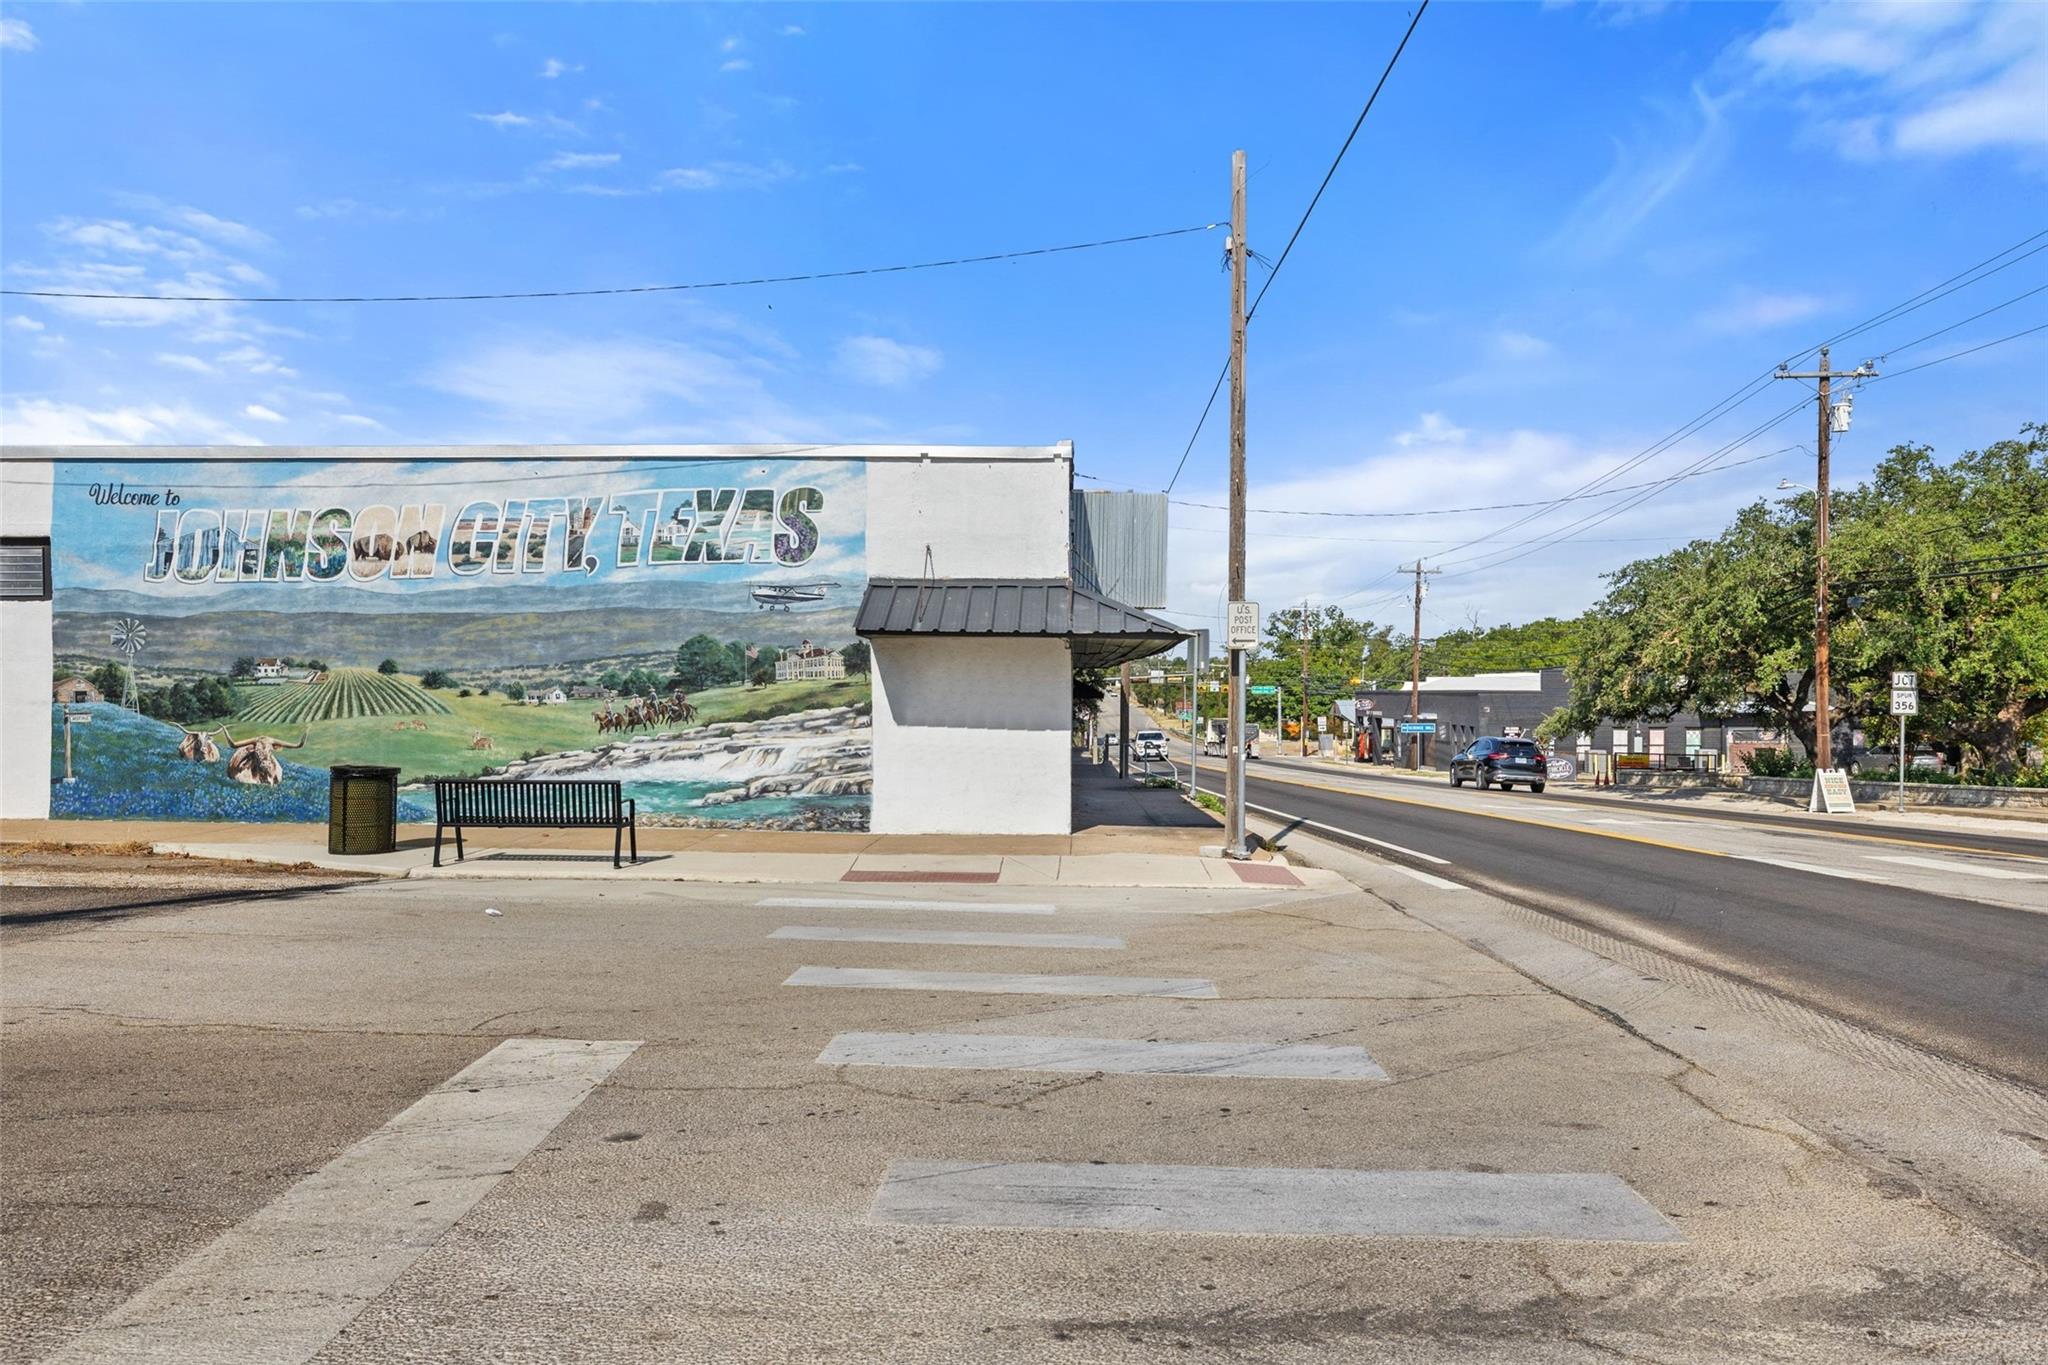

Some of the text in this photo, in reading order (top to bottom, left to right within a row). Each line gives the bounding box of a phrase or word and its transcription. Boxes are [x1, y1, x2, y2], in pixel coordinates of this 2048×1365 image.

[89, 482, 181, 506] Welcome to
[144, 486, 825, 584] JOHNSON CITY, TEXAS
[1234, 616, 1252, 624] POST
[1230, 625, 1256, 634] OFFICE
[1894, 674, 1914, 686] JCT
[1894, 701, 1914, 711] 356
